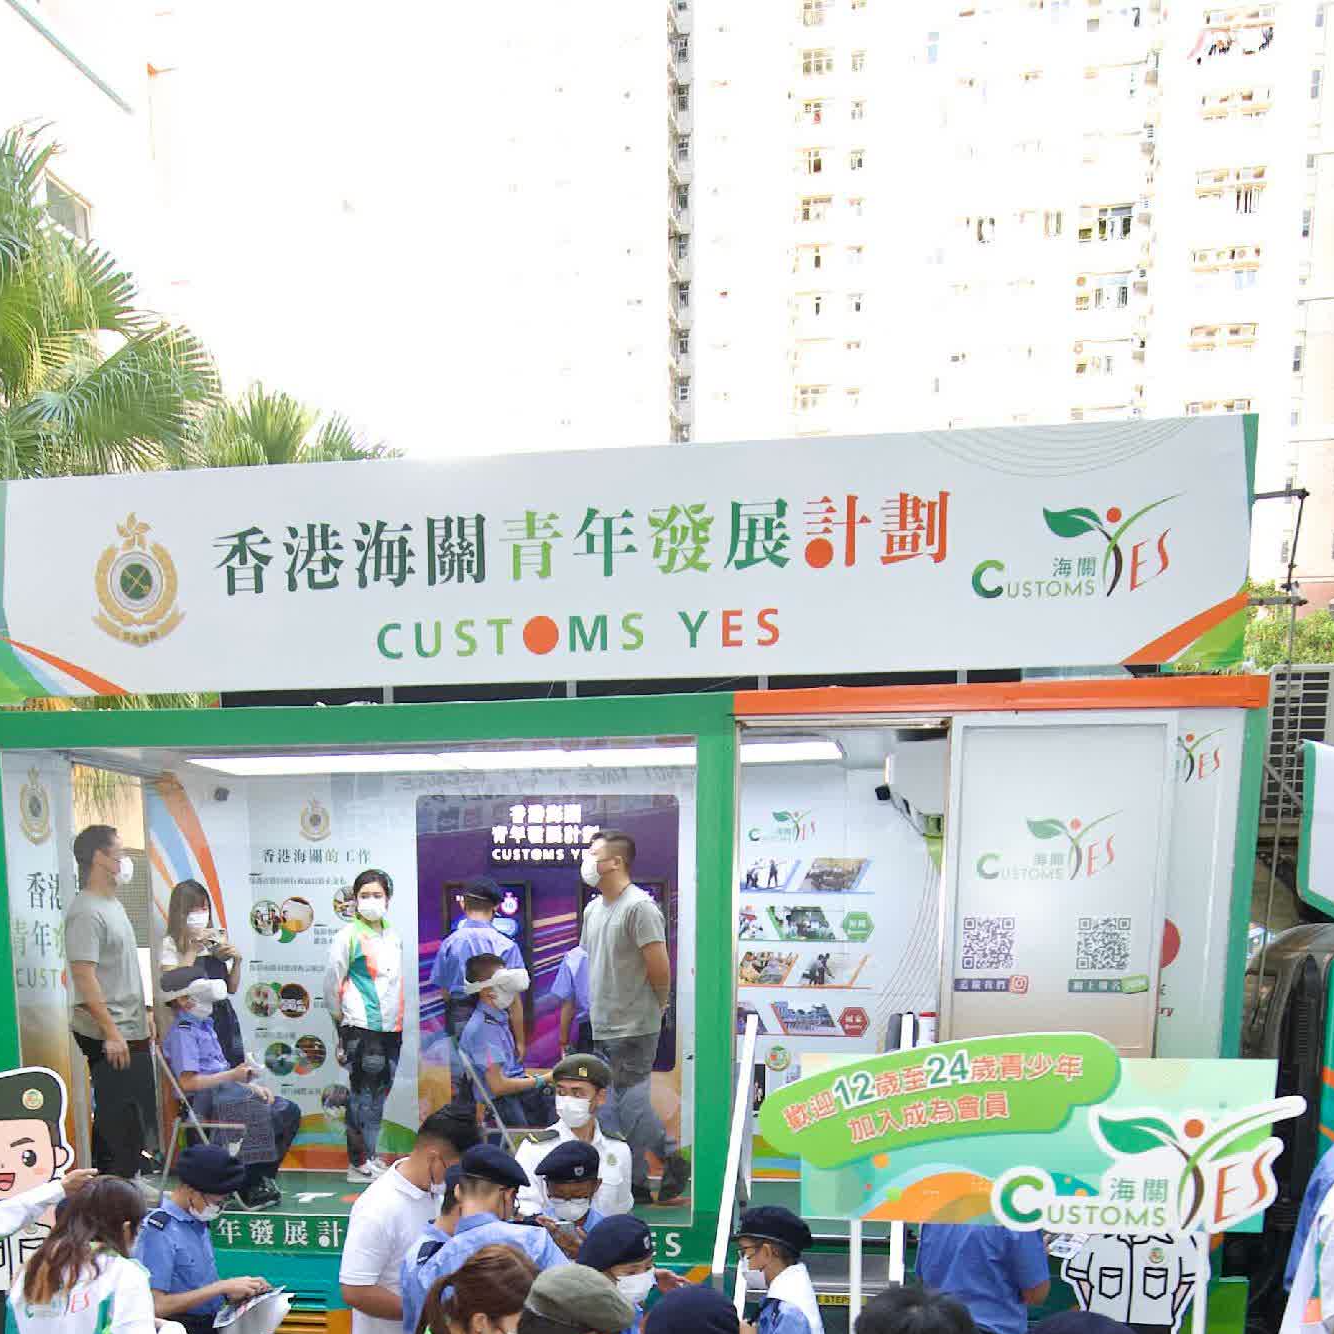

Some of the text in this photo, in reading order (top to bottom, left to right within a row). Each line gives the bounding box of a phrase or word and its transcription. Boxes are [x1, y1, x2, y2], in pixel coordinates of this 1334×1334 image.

[212, 490, 951, 597] 香港海關青年發展計劃
[971, 494, 1183, 599] CUSTOMS YES
[1052, 556, 1097, 578] 海關
[376, 608, 780, 660] CUSTOMS YES
[492, 848, 565, 861] CUSTOMS
[783, 1051, 1083, 1131] 歡迎12歲至24歲青少年
[848, 1091, 1009, 1143] 加入成為會員
[1000, 1112, 1277, 1230] CUSTOMS YES
[1109, 1177, 1169, 1203] 海關
[215, 1218, 345, 1248] 年發展計
